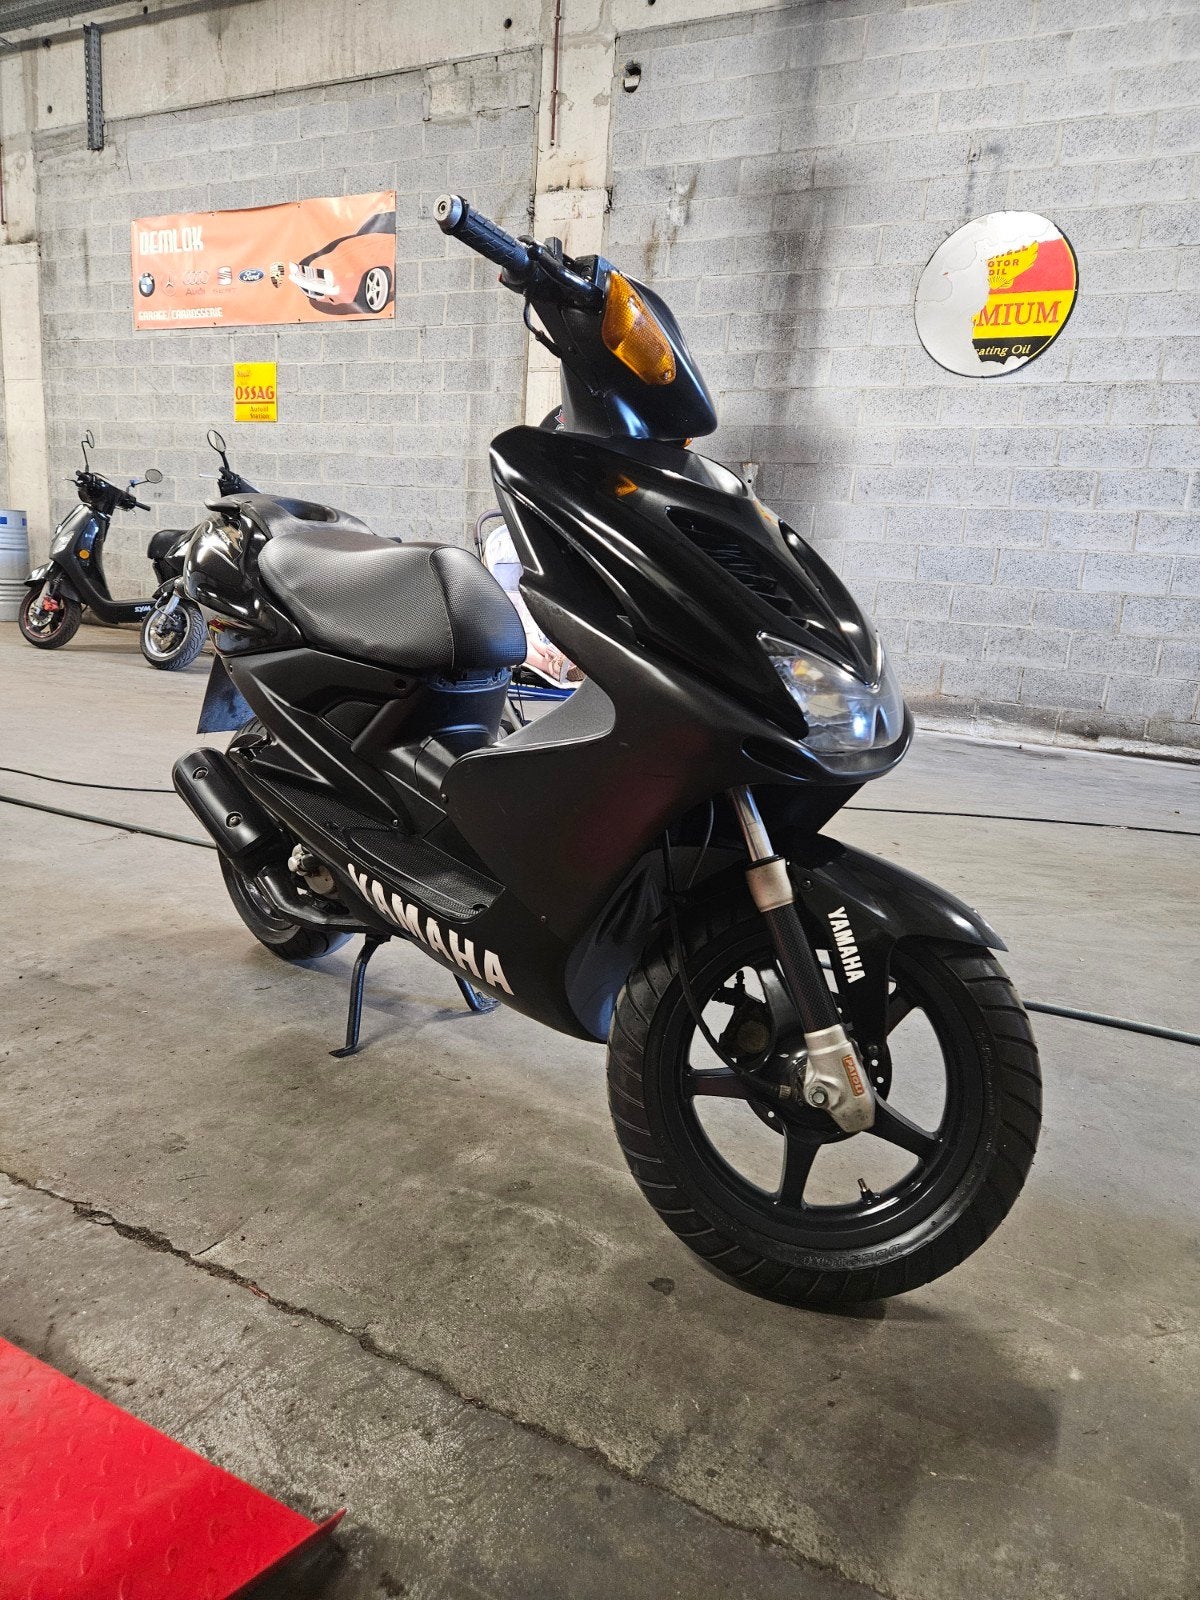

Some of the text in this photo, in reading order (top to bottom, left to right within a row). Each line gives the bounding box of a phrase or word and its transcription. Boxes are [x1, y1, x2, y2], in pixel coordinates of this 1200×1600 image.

[973, 301, 1062, 327] MIUM
[1011, 344, 1032, 355] Oil
[235, 385, 275, 400] OSSAG
[347, 863, 514, 996] YAMAHA
[828, 906, 866, 984] YAMAHA
